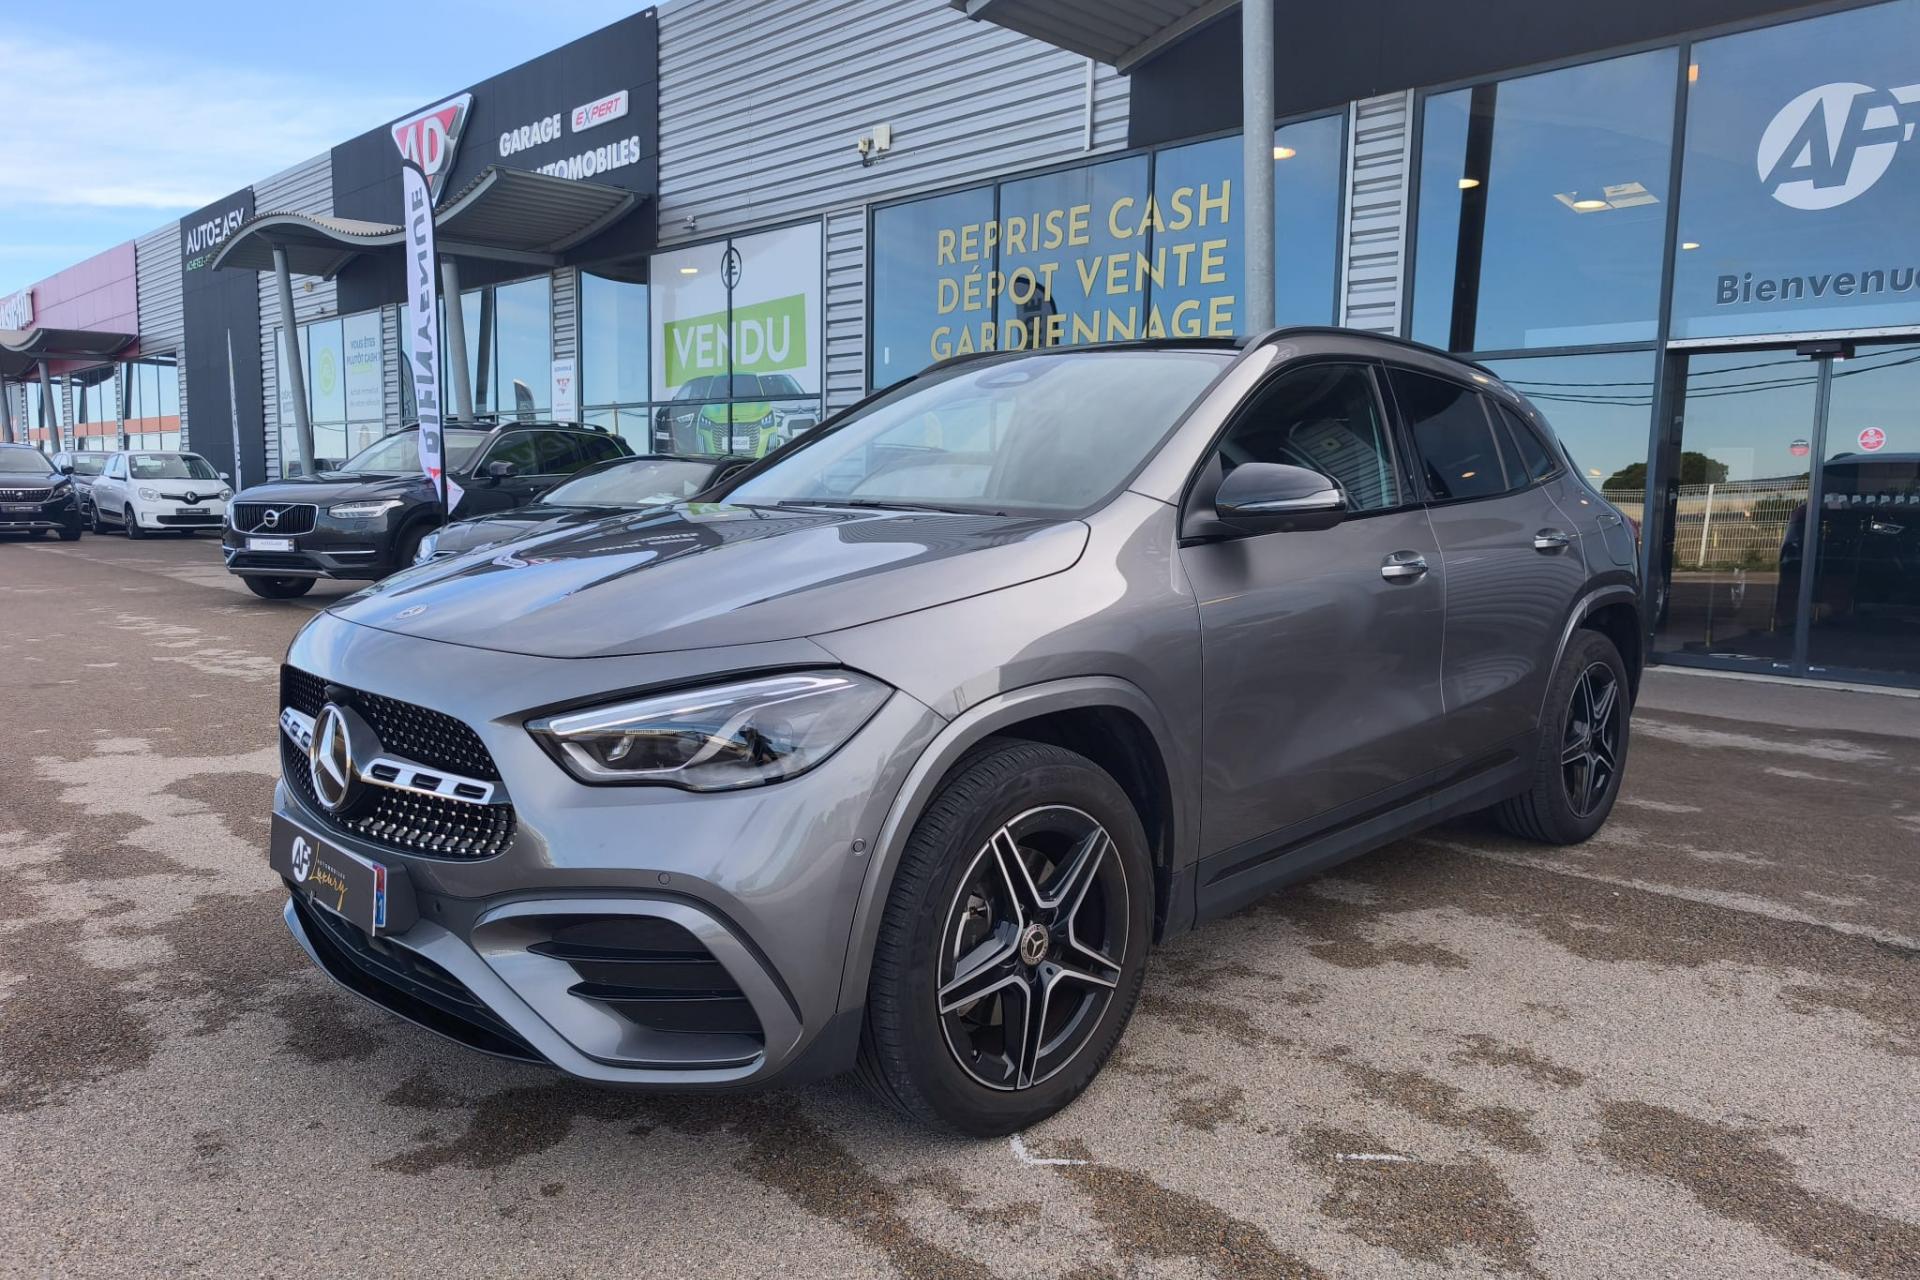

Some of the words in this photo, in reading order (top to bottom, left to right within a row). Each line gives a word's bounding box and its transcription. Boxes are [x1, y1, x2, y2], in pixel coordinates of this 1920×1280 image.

[405, 116, 446, 176] AD
[499, 113, 561, 157] GARAGE
[575, 96, 621, 126] EXPERT
[186, 208, 244, 255] AUTOEASY
[937, 204, 1092, 266] REPRISE
[1108, 179, 1232, 240] CASH
[937, 262, 1060, 315] DÉPOT
[1076, 239, 1228, 298] VENTE
[1716, 267, 1920, 305] Bienvenu
[672, 315, 791, 370] VENDU
[930, 295, 1236, 362] GARDIENNAGE
